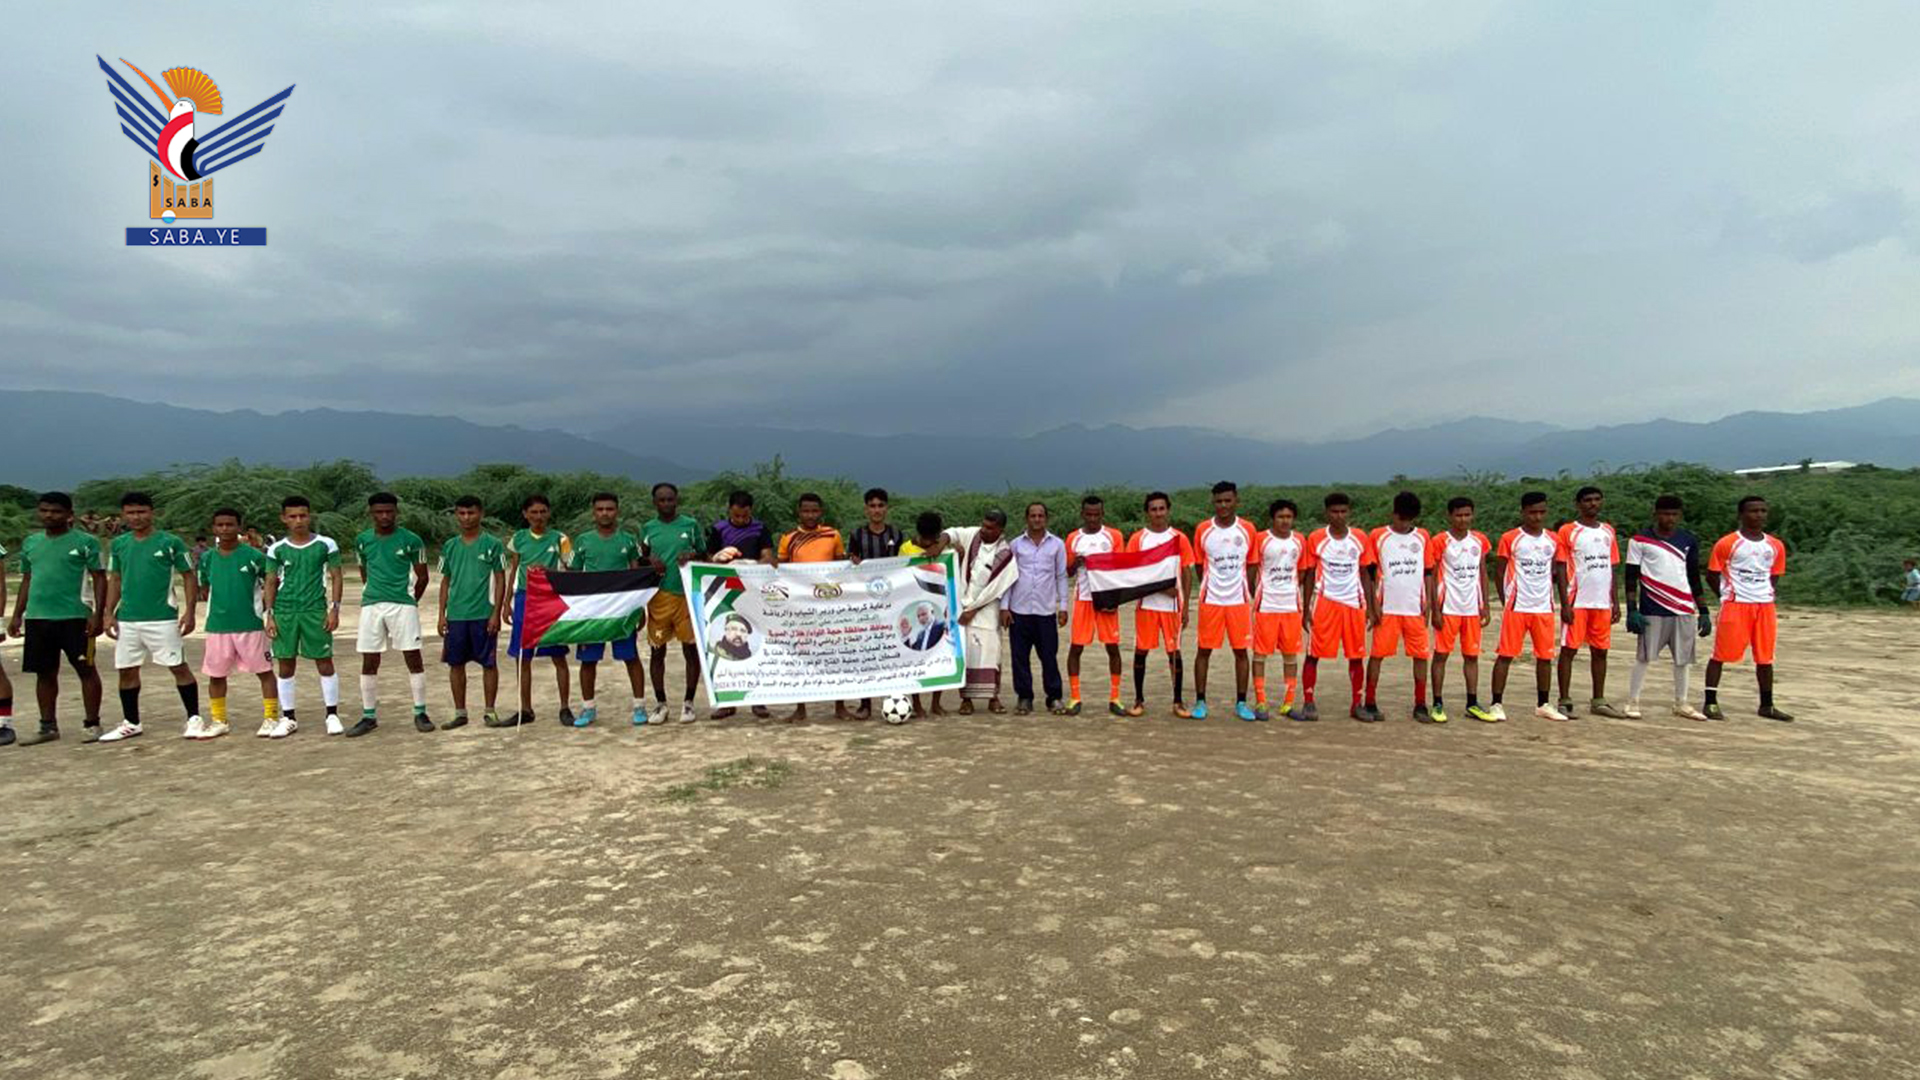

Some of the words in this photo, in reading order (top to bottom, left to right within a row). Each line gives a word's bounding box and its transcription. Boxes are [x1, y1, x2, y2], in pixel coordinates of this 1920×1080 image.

[793, 605, 814, 615] الشباب
[818, 604, 834, 613] وزير
[834, 603, 845, 612] من
[846, 601, 866, 611] كريمة
[762, 607, 792, 618] والرياضة
[826, 626, 840, 635] حجة
[882, 642, 896, 651] حجة
[876, 652, 900, 661] فلسطين
